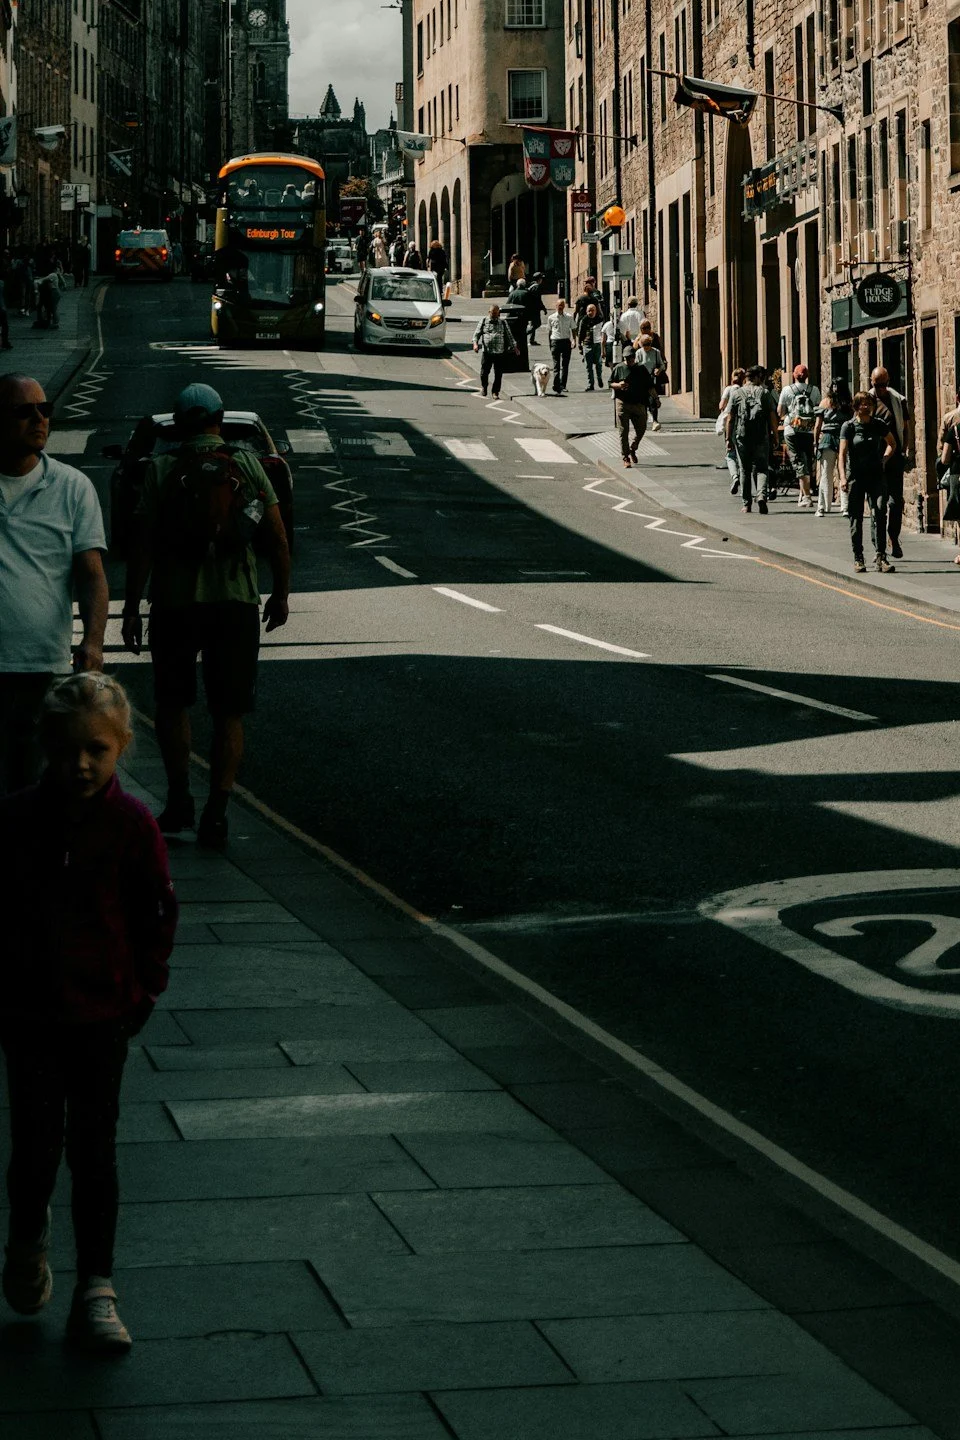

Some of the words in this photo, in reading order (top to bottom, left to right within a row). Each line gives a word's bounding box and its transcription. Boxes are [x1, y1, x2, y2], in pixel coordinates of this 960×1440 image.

[246, 228, 279, 240] Edinburgh
[280, 229, 296, 239] Tour
[864, 287, 894, 297] FUDGE
[865, 295, 894, 304] HOUSE
